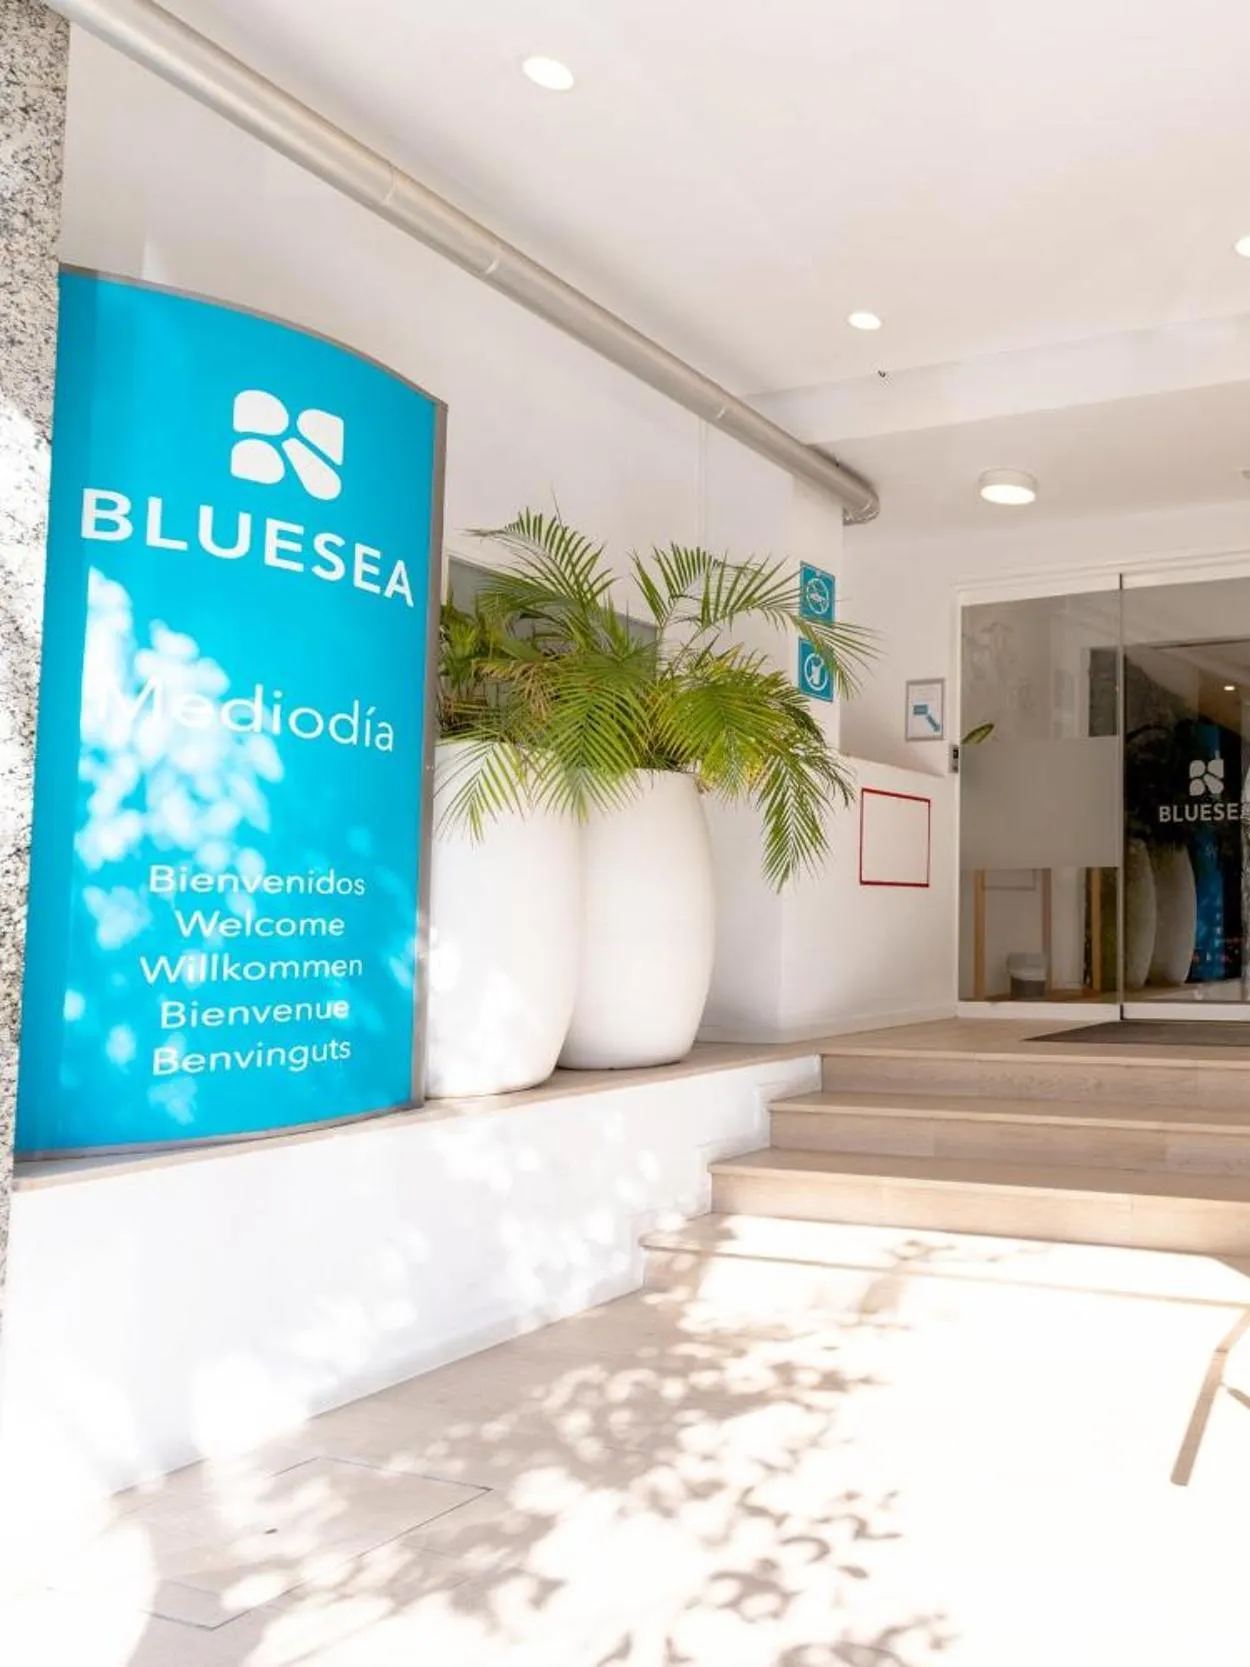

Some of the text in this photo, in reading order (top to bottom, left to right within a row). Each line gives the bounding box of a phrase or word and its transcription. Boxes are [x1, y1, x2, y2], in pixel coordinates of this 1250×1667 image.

[80, 487, 415, 608] BLUESEA
[99, 674, 394, 752] Mediodía
[149, 864, 366, 896] Bienvenidos
[174, 910, 346, 938] Welcome
[139, 952, 363, 985] Willkommen
[161, 1000, 350, 1029] Bienvenue
[152, 1039, 352, 1077] Benvinguts
